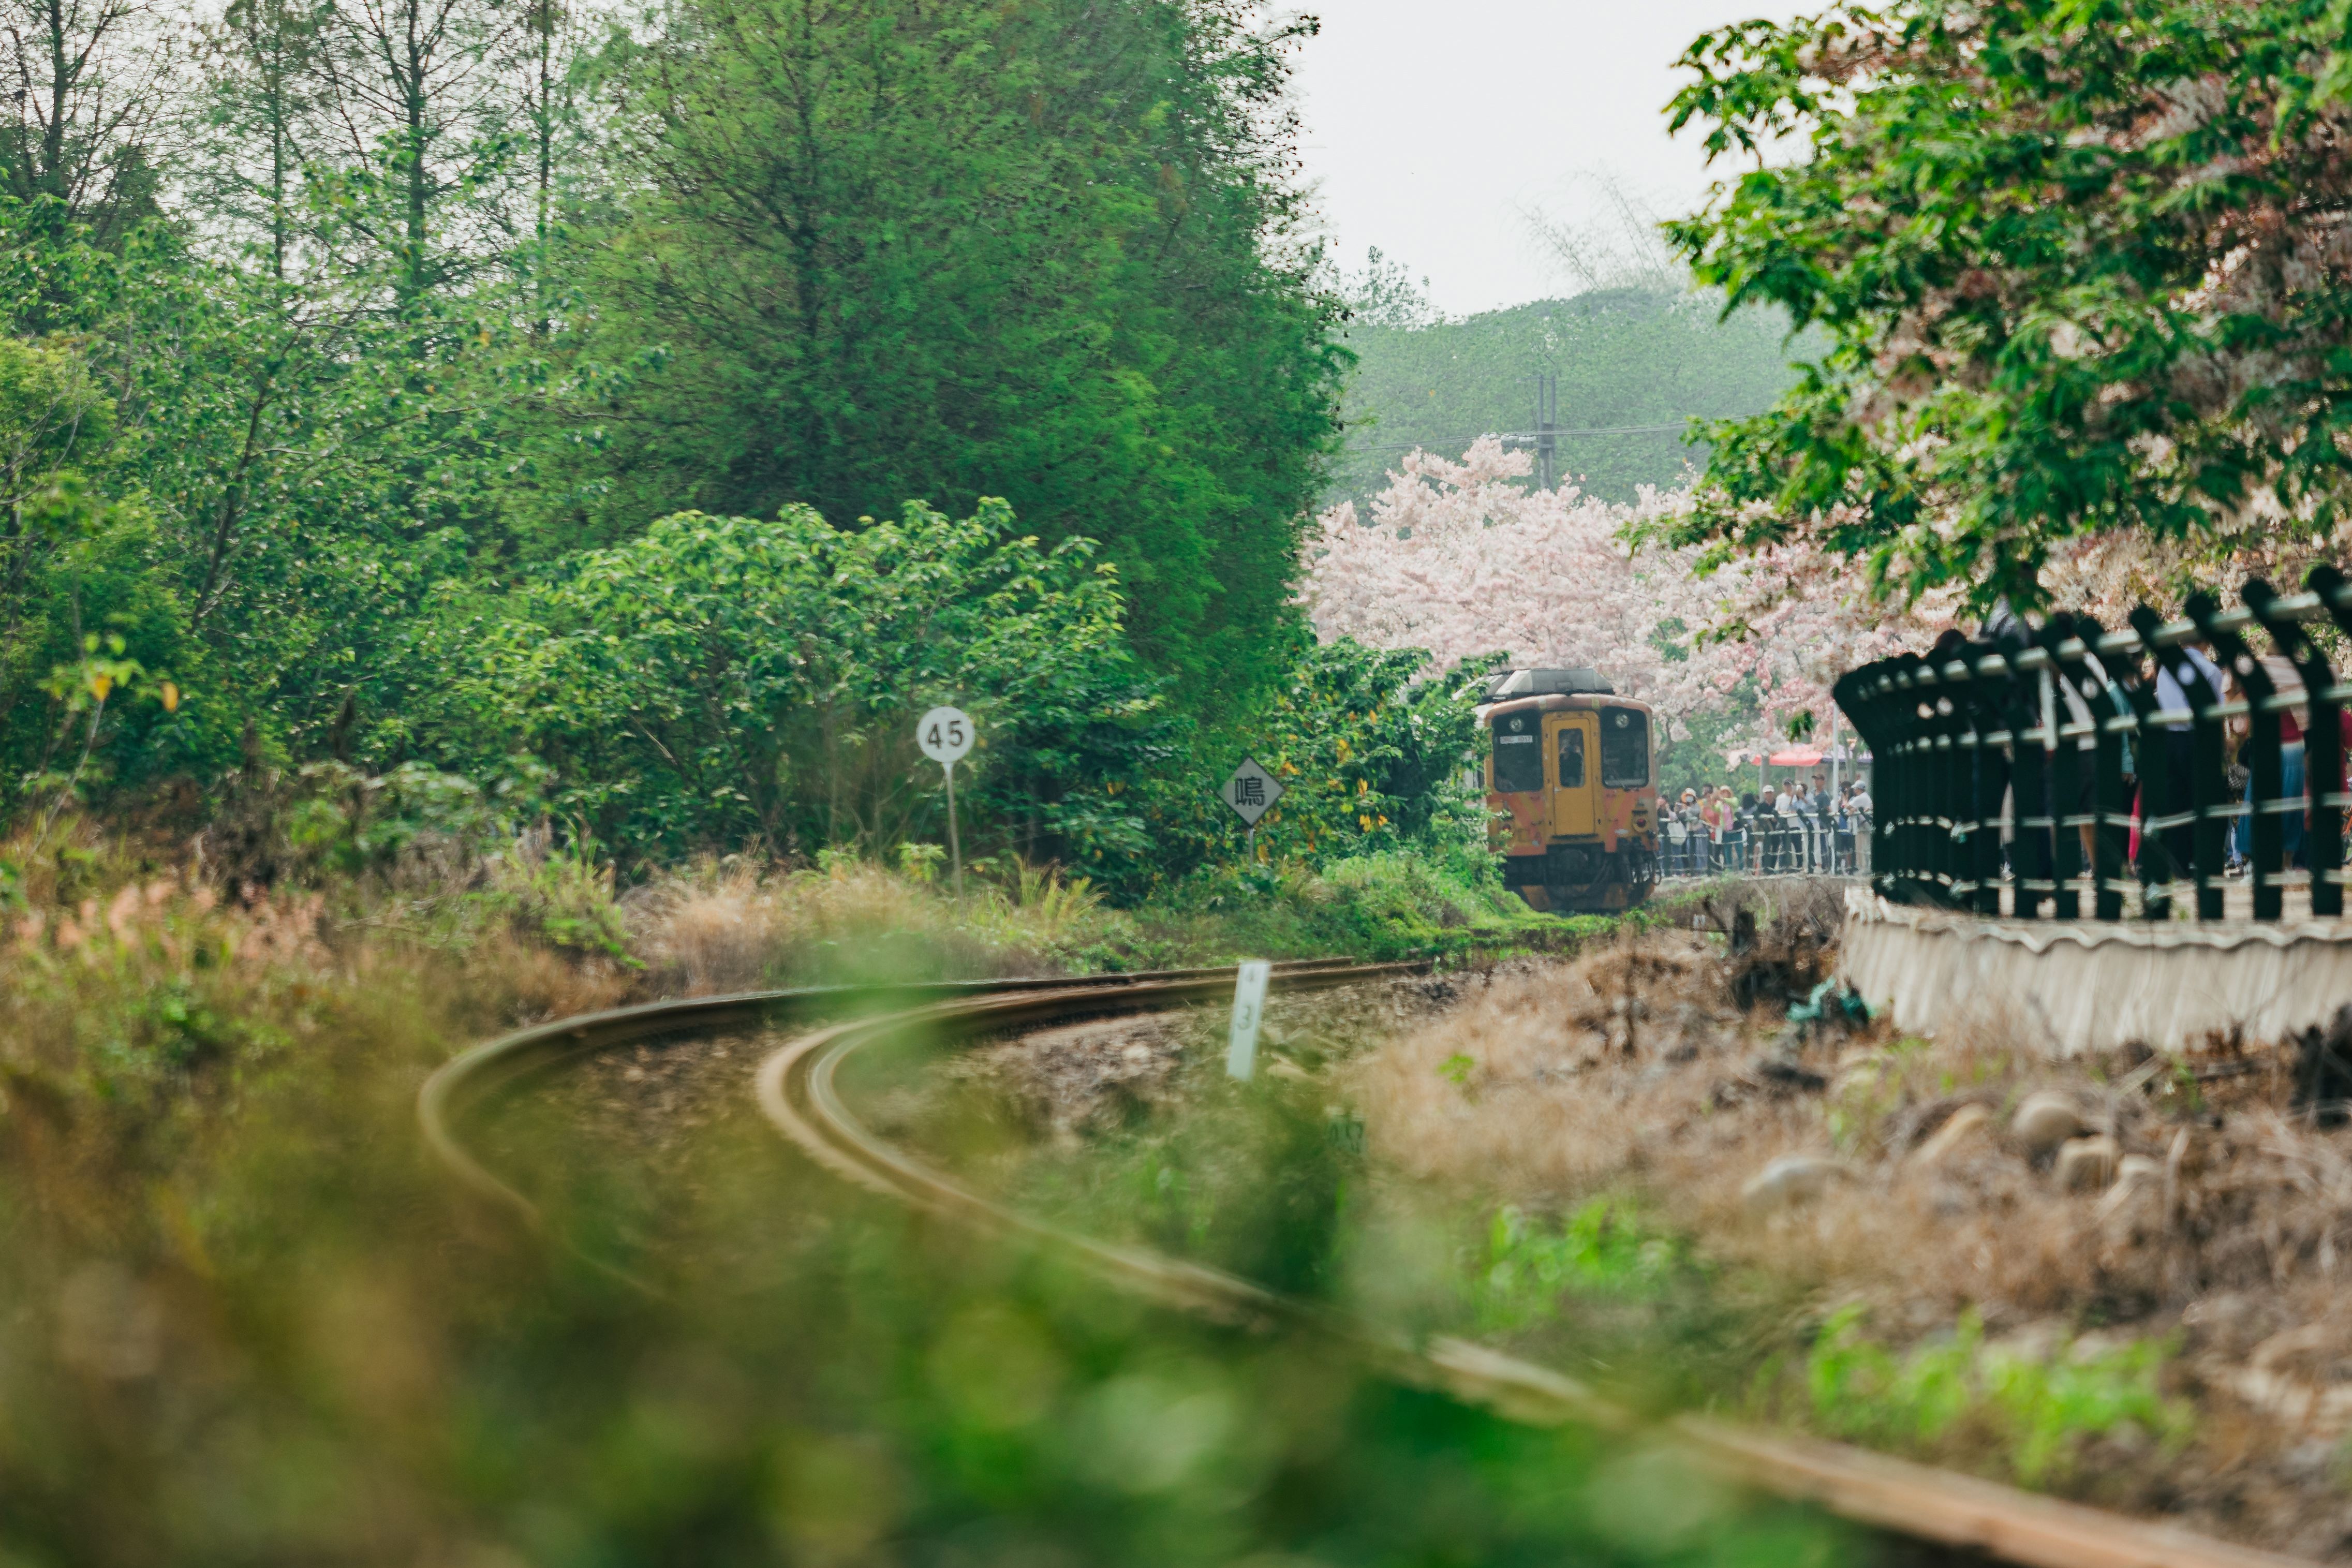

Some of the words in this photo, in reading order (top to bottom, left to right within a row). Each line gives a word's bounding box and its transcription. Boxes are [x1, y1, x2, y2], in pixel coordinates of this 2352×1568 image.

[927, 720, 964, 749] 45
[1235, 776, 1265, 806] 鳴
[1237, 1004, 1252, 1030] 3
